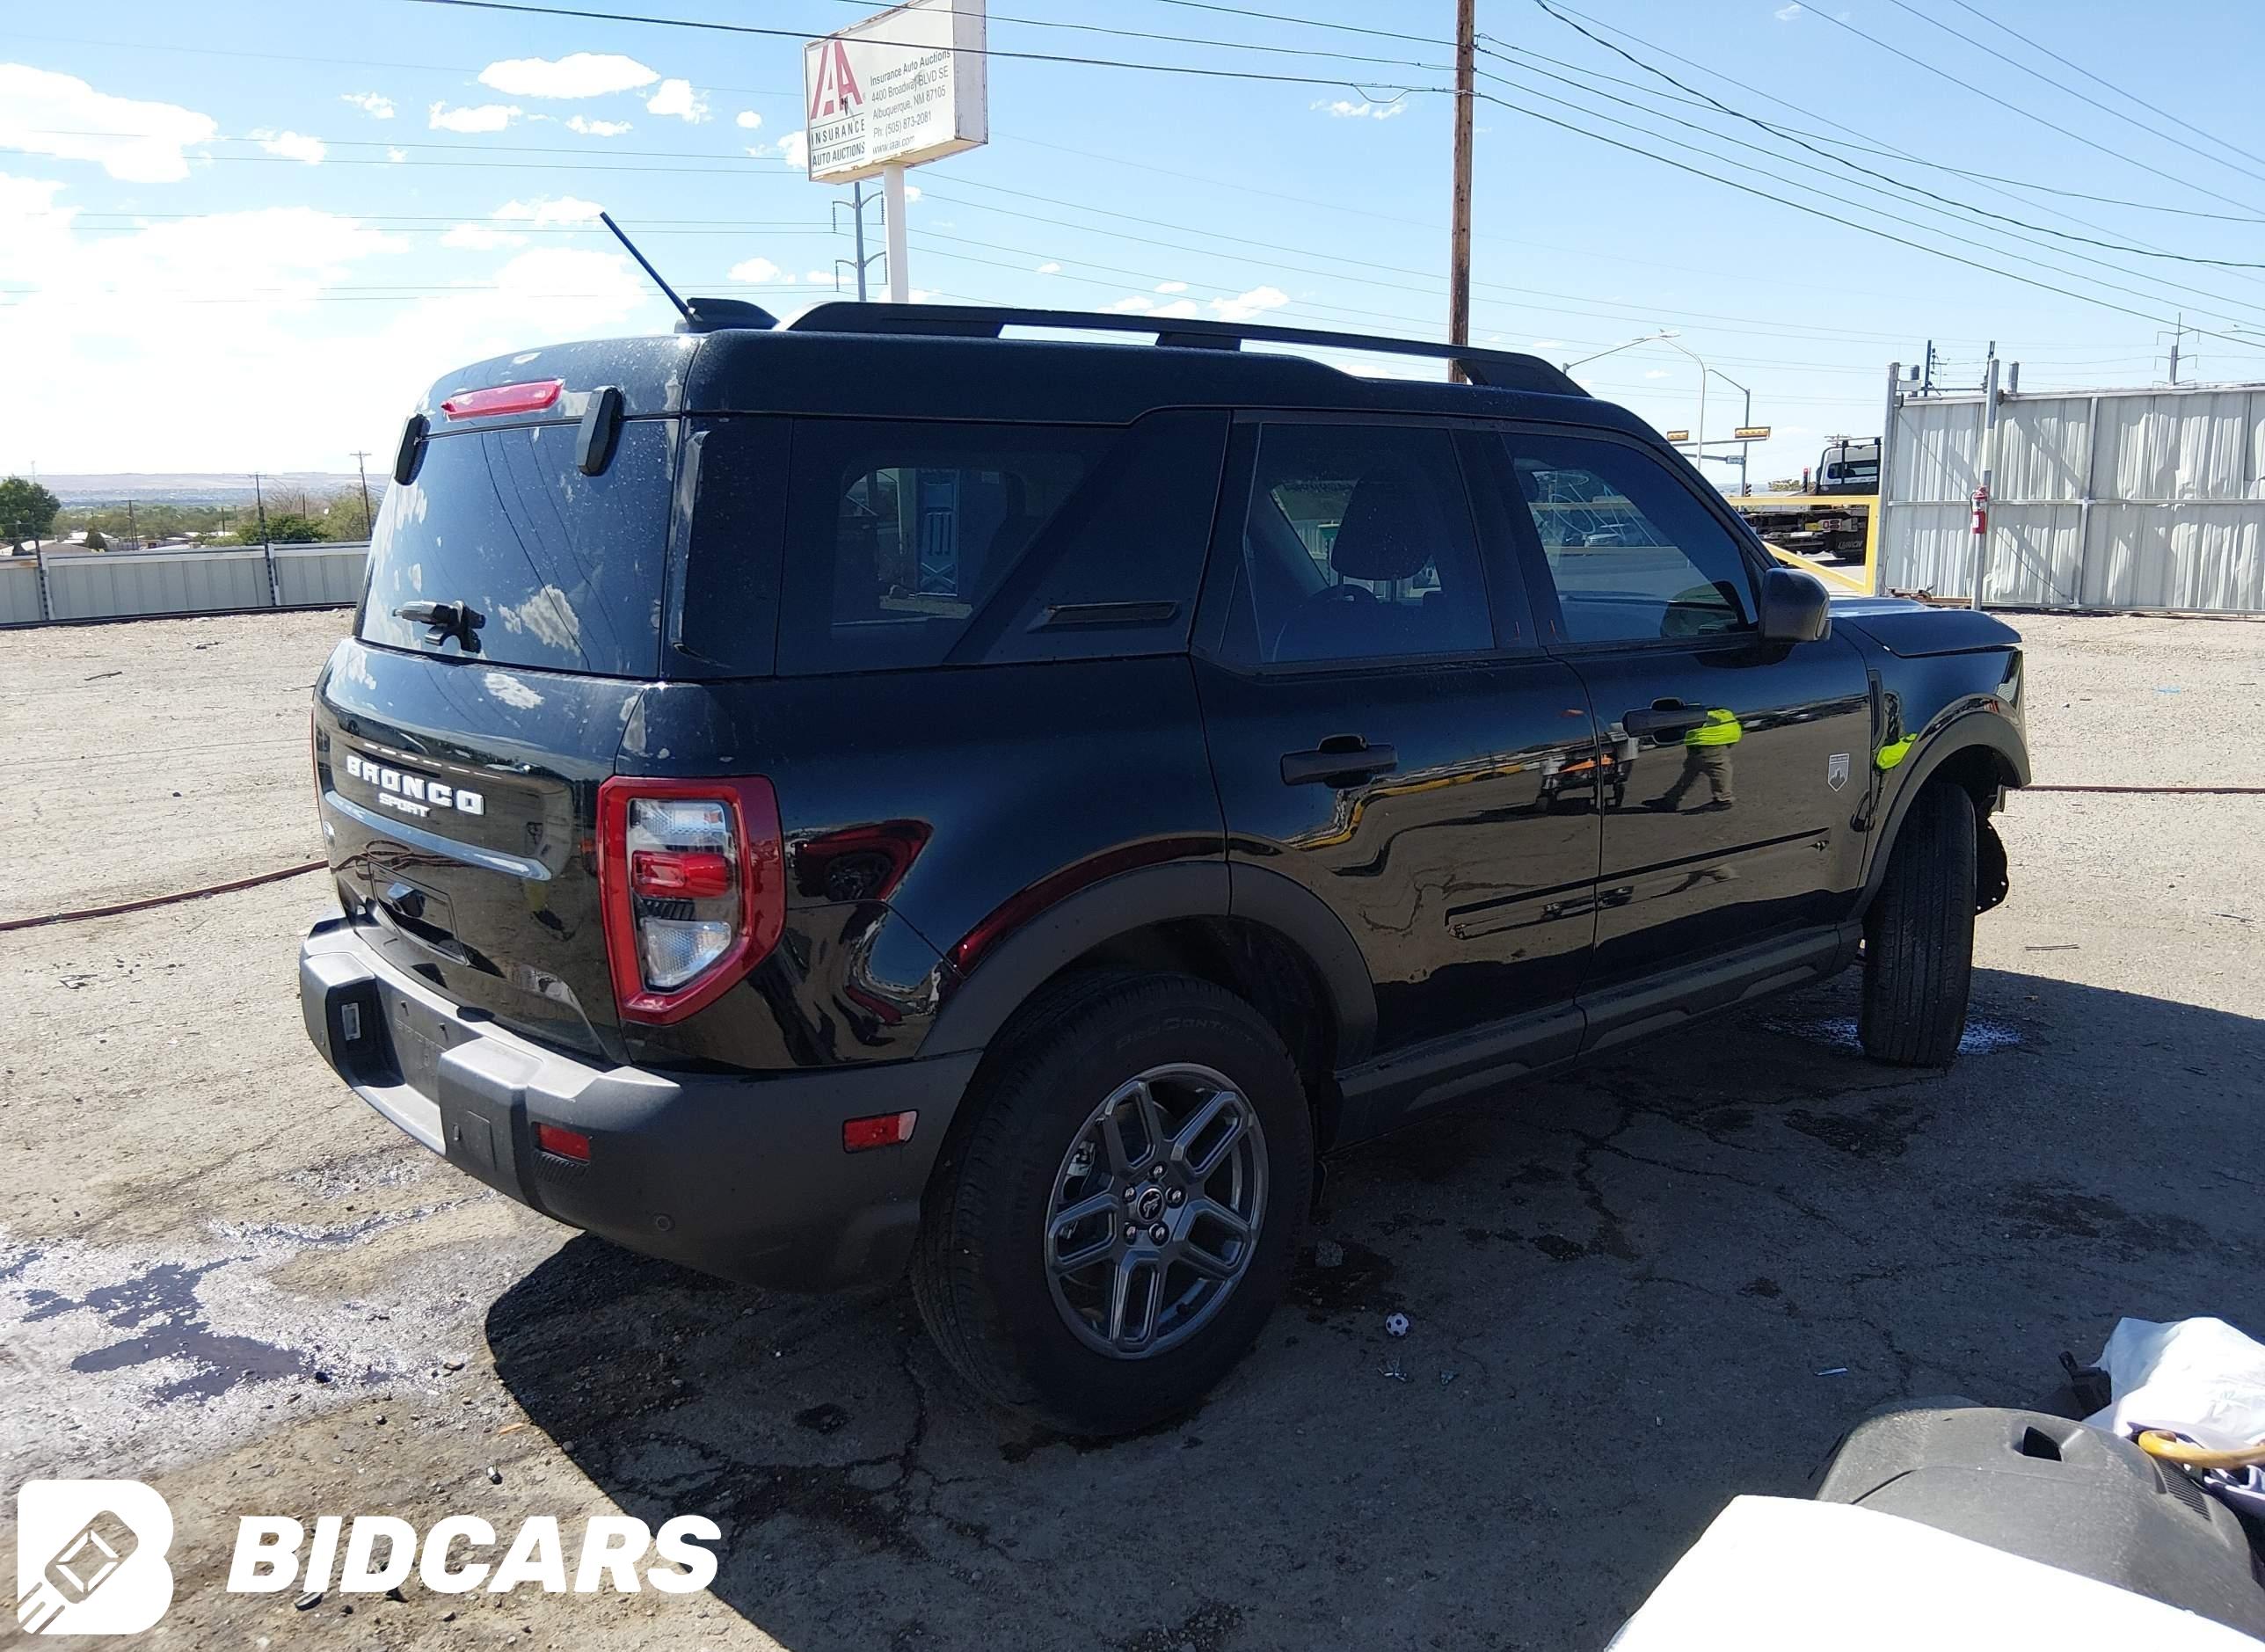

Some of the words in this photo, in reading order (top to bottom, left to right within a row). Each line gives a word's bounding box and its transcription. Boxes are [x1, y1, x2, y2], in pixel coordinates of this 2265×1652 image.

[870, 68, 902, 86] Insurance
[903, 61, 918, 75] Auto
[920, 50, 950, 68] Auctions
[871, 89, 887, 102] 4400
[888, 81, 916, 98] Broadway
[918, 70, 937, 86] BLVD
[938, 66, 949, 79] SE
[873, 100, 912, 120] Albuquerque,
[914, 91, 925, 106] NM
[926, 86, 946, 102] 87105
[811, 119, 865, 146] INSURANCE
[885, 120, 902, 137] (505)
[903, 111, 932, 129] 873-2081
[812, 151, 831, 167] AUTO
[832, 141, 865, 163] AUCTIONS
[346, 754, 484, 816] BRONCO
[379, 792, 431, 818] SPORT
